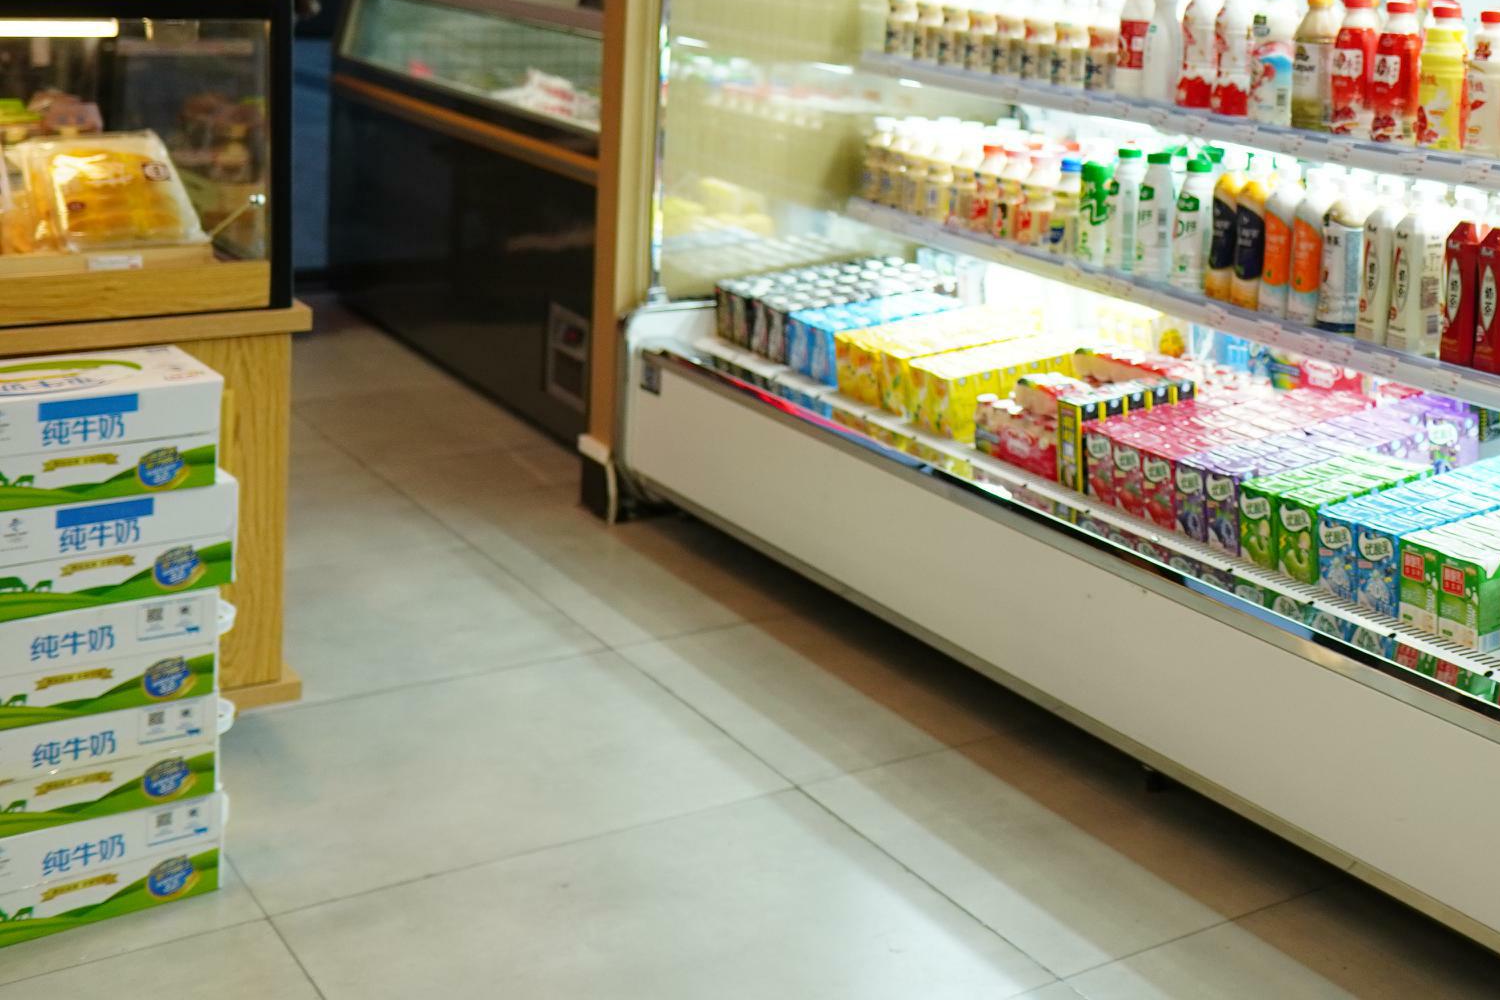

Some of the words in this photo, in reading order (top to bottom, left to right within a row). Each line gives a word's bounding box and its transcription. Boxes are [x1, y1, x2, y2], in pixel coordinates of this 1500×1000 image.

[42, 414, 125, 446] 纯牛奶
[59, 519, 141, 552] 纯牛奶
[30, 625, 115, 661] 纯牛奶
[32, 731, 116, 768] 纯牛奶
[42, 834, 125, 876] 纯牛奶
